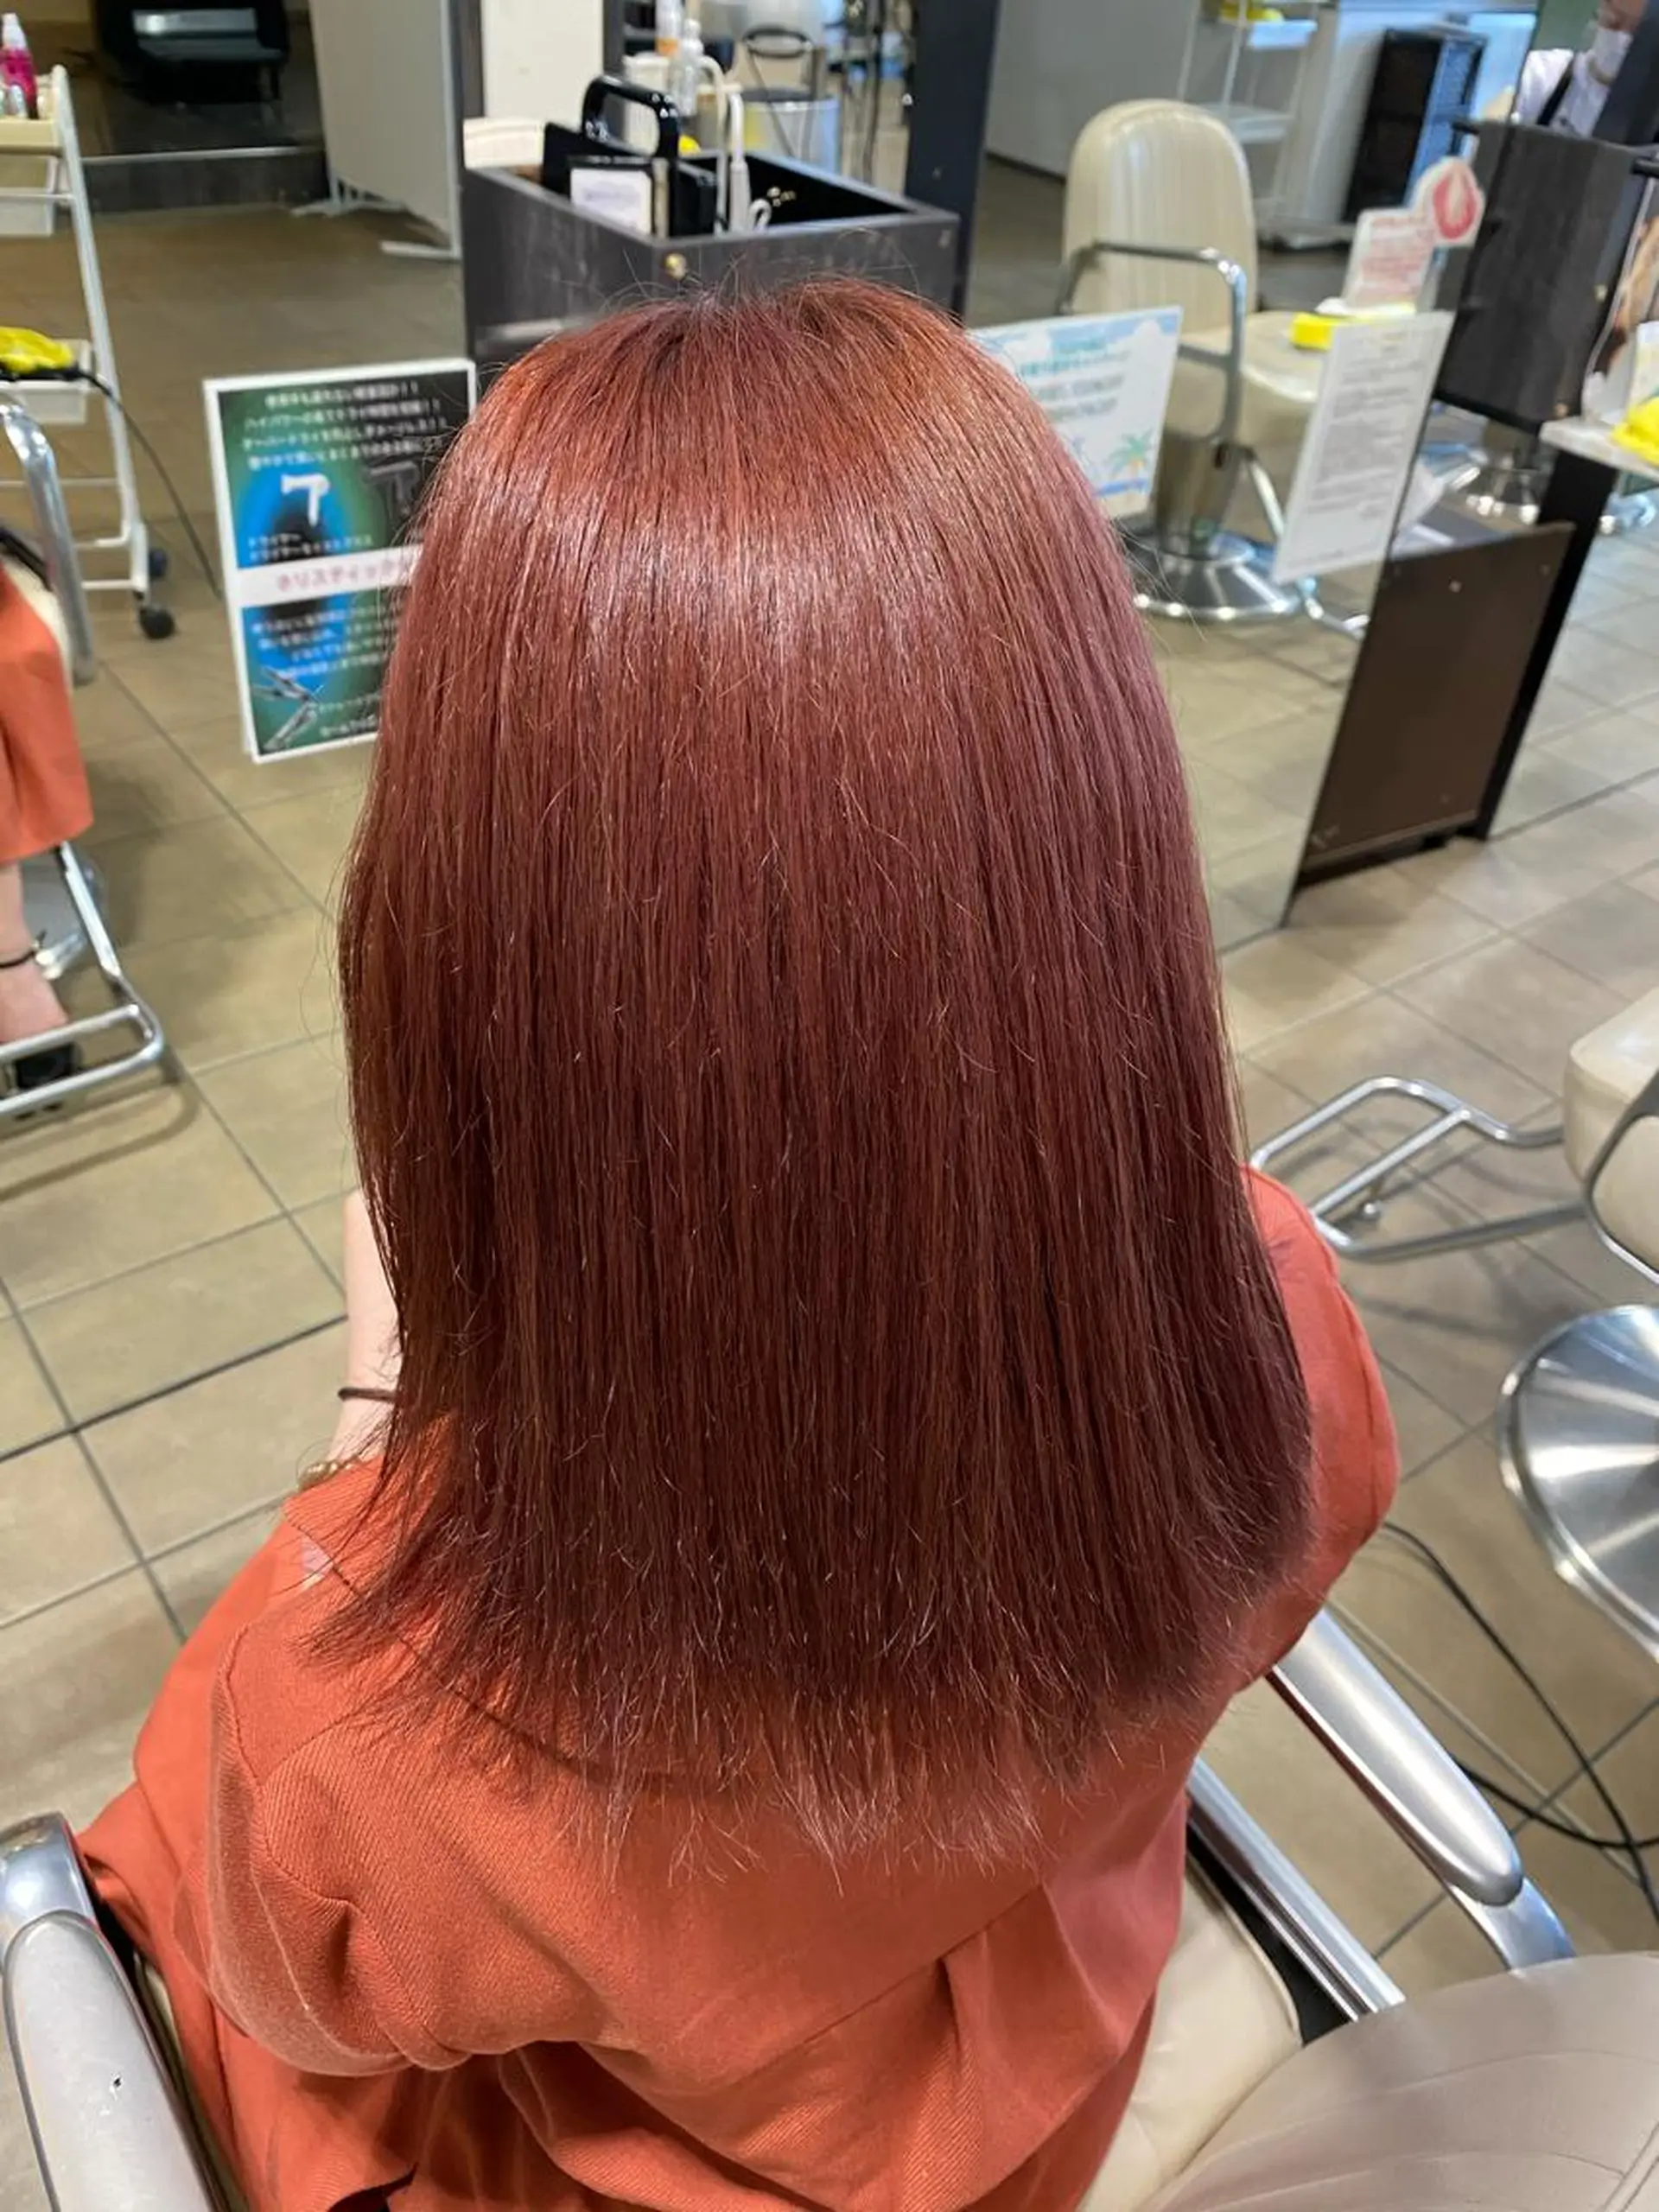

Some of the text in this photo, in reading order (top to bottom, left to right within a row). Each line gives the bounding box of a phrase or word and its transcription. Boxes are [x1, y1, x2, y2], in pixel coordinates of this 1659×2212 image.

[278, 557, 404, 592] ホリスティック
